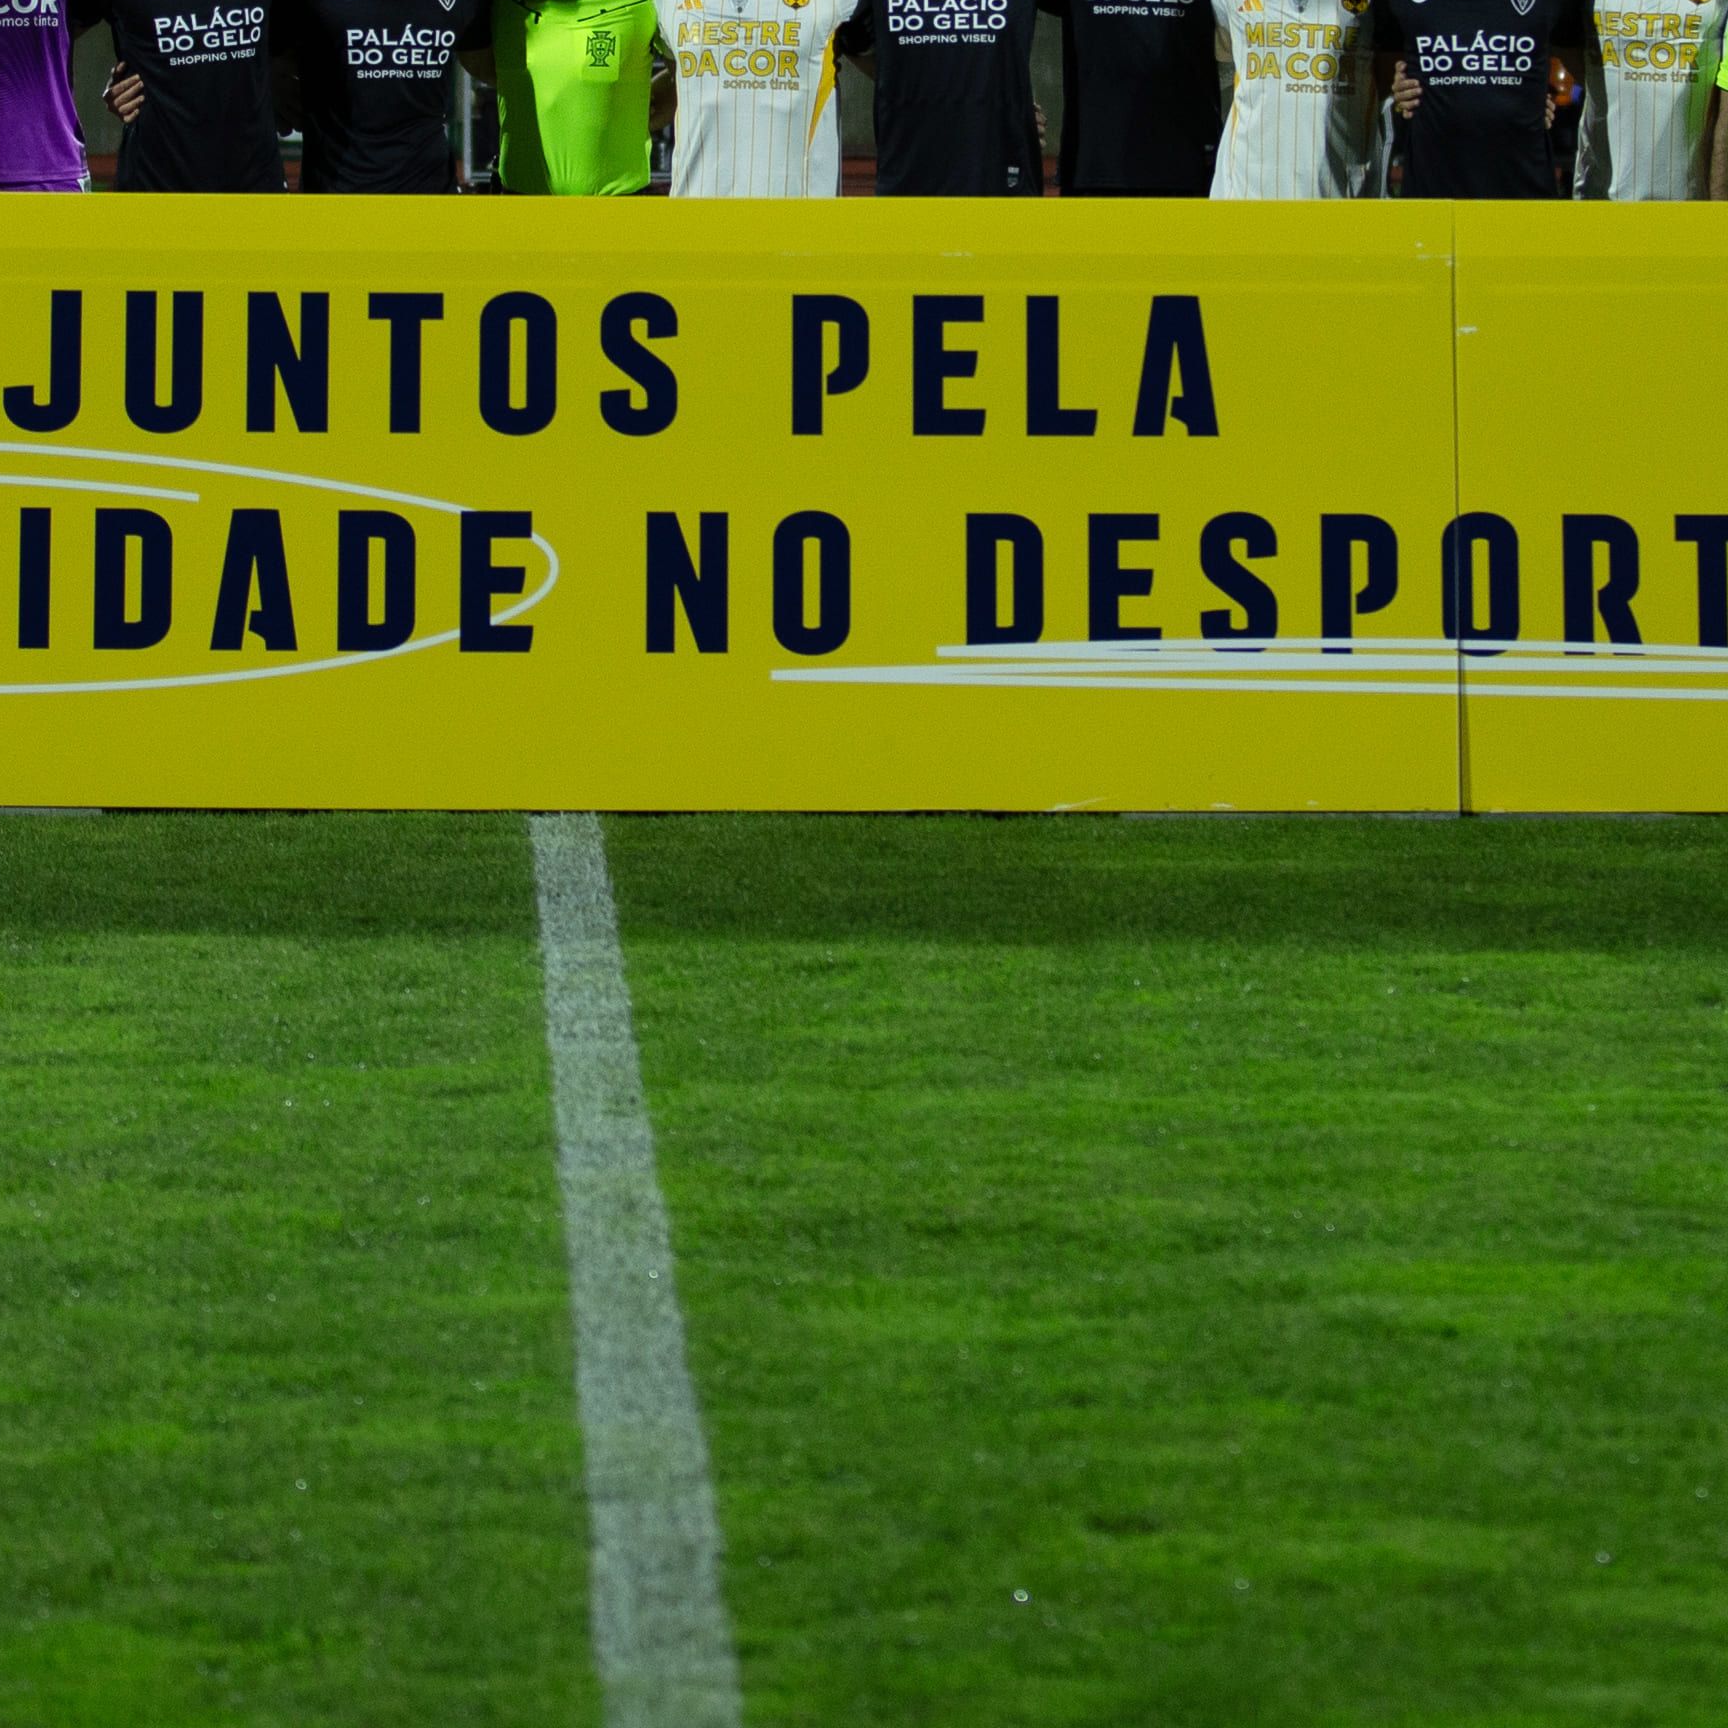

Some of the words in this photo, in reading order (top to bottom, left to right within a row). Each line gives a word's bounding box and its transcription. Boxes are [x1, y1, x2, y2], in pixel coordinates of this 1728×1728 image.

[33, 15, 59, 28] tinta
[154, 6, 265, 36] PALÁCIO
[888, 15, 924, 32] DO
[933, 13, 1007, 30] GELO
[1092, 5, 1149, 16] SHOPPING
[157, 34, 194, 53] DO
[203, 26, 261, 49] GELO
[346, 24, 455, 47] PALÁCIO
[677, 21, 801, 47] MESTRE
[898, 34, 958, 45] SHOPPING
[961, 34, 996, 44] VISEU
[1245, 22, 1360, 50] MESTRE
[1415, 29, 1536, 55] PALÁCIO
[169, 51, 228, 66] SHOPPING
[347, 48, 384, 65] DO
[392, 48, 450, 65] GELO
[678, 49, 720, 78] DA
[723, 48, 800, 78] COR
[1246, 51, 1281, 80] DA
[1419, 55, 1453, 72] DO
[1461, 53, 1533, 72] GELO
[1624, 40, 1700, 70] COR
[356, 69, 414, 79] SHOPPING
[1428, 75, 1487, 86] SHOPPING
[1490, 75, 1523, 86] VISEU
[2, 289, 678, 437] JUNTOS
[791, 294, 1219, 437] PELA
[646, 510, 851, 656] NO
